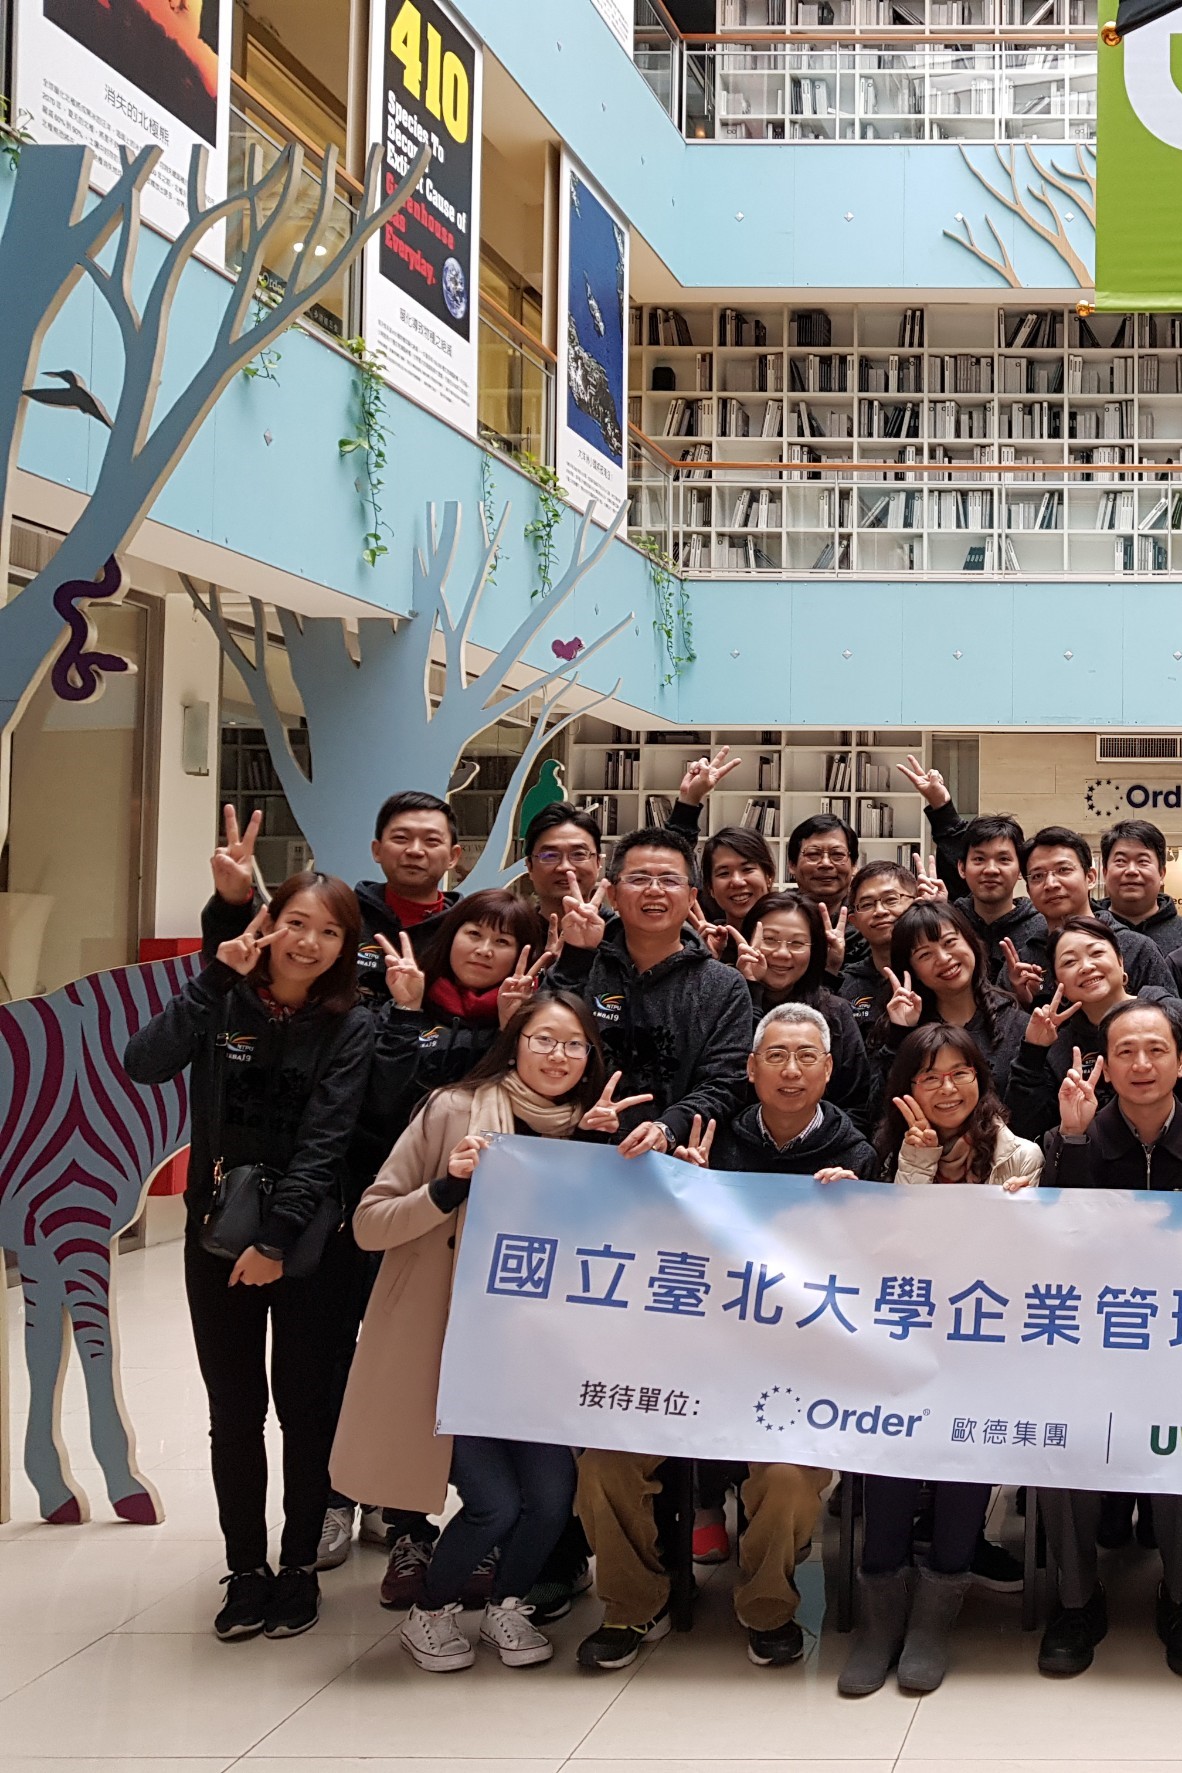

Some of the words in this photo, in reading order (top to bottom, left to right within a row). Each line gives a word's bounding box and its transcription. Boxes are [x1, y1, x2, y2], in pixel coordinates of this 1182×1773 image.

[391, 0, 469, 144] 410
[104, 83, 170, 147] 消失的北極熊
[387, 90, 429, 144] Species
[431, 131, 445, 164] To
[387, 115, 429, 174] Beco
[386, 140, 424, 194] Extit
[426, 178, 455, 224] Cause
[456, 212, 467, 234] of
[386, 171, 455, 251] Genhouse
[385, 226, 437, 286] Everyday.
[951, 1417, 1069, 1449] 歐德集團
